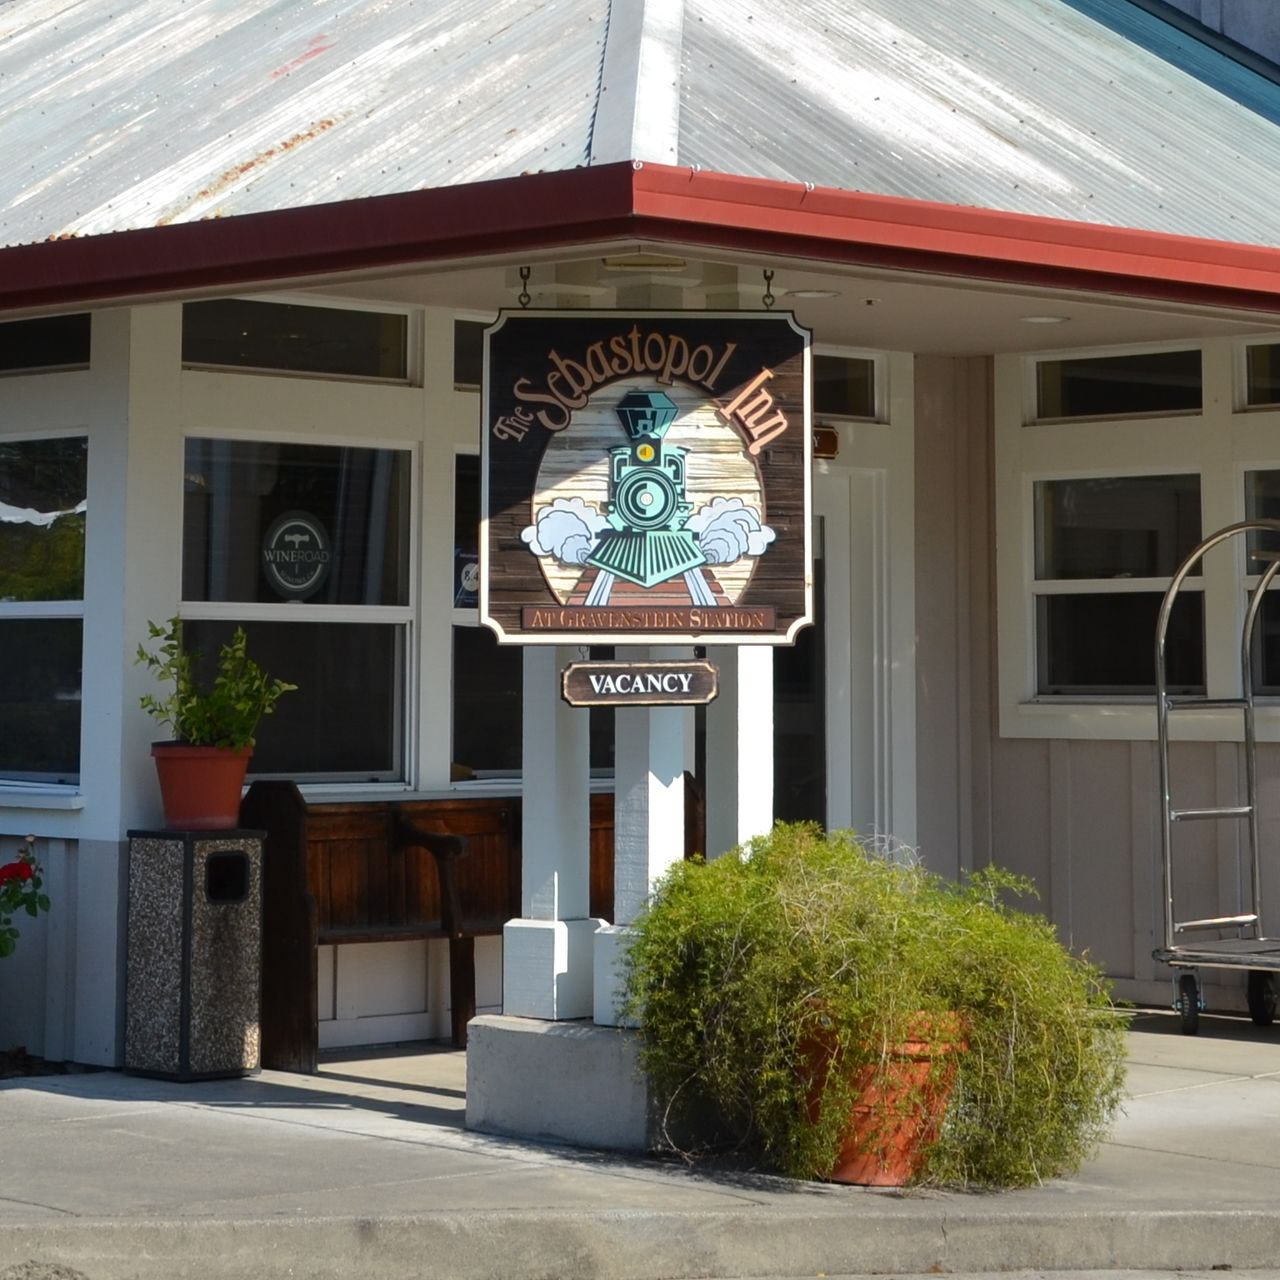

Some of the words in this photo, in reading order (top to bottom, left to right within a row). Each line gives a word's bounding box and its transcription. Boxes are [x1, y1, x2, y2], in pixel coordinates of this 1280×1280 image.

[513, 324, 736, 431] Sebastopol
[493, 406, 535, 442] The
[720, 367, 788, 454] Inn
[589, 673, 693, 694] VACANCY
